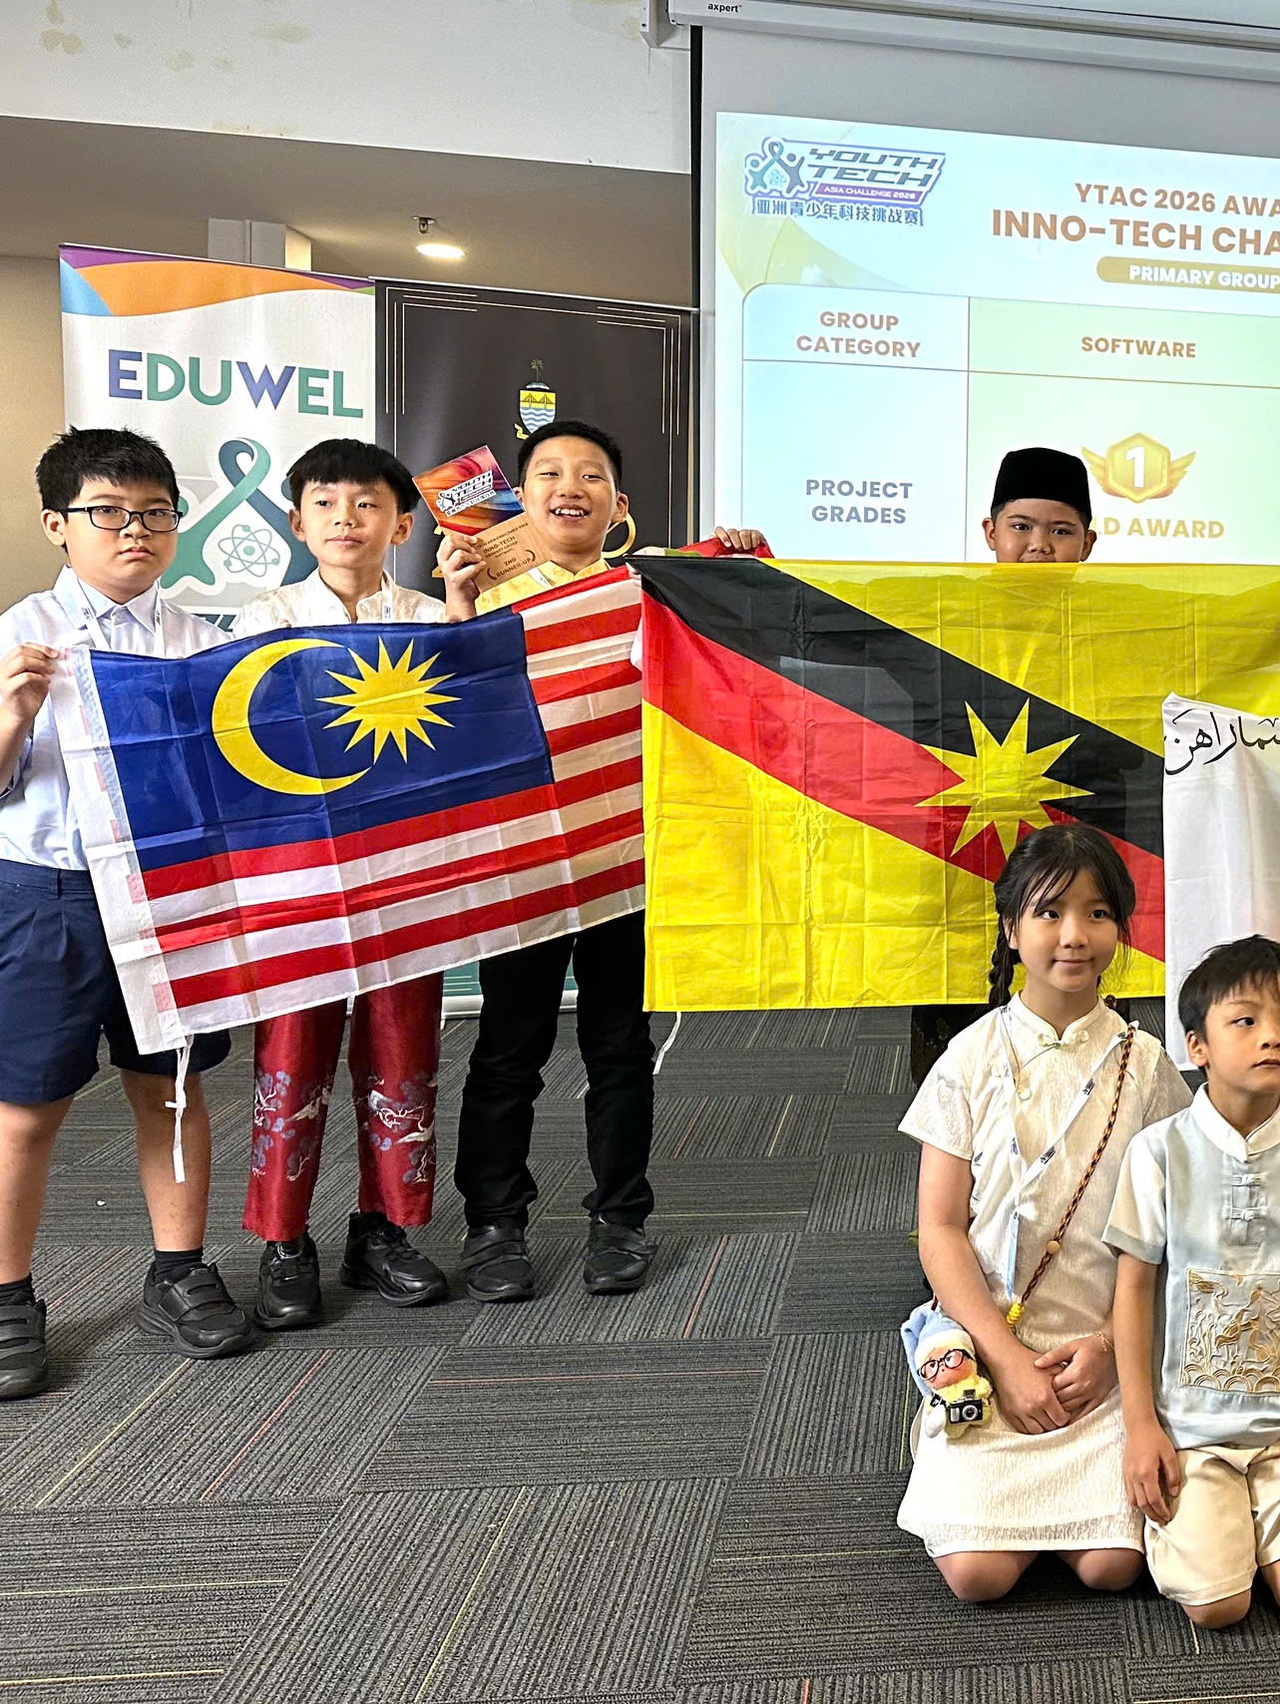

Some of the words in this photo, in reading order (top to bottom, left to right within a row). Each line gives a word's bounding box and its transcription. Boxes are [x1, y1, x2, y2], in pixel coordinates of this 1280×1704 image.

[808, 147, 939, 170] YOUTH
[807, 164, 933, 188] TECH
[824, 186, 845, 194] ASIA
[845, 188, 892, 198] CHALLENGE
[1075, 183, 1147, 208] YTAC
[1154, 190, 1216, 213] 2026
[756, 200, 920, 226] 亚洲青少年科技挑战赛
[992, 209, 1203, 251] INNO-TECH
[1129, 265, 1214, 287] PRIMARY
[819, 311, 900, 331] GROUP
[796, 335, 922, 359] CATEGORY
[1081, 336, 1197, 359] SOFTWARE
[108, 349, 364, 418] EDUWEL
[1125, 446, 1146, 489] 1
[805, 479, 913, 500] PROJECT
[811, 505, 906, 525] GRADES
[1127, 518, 1225, 539] AWARD
